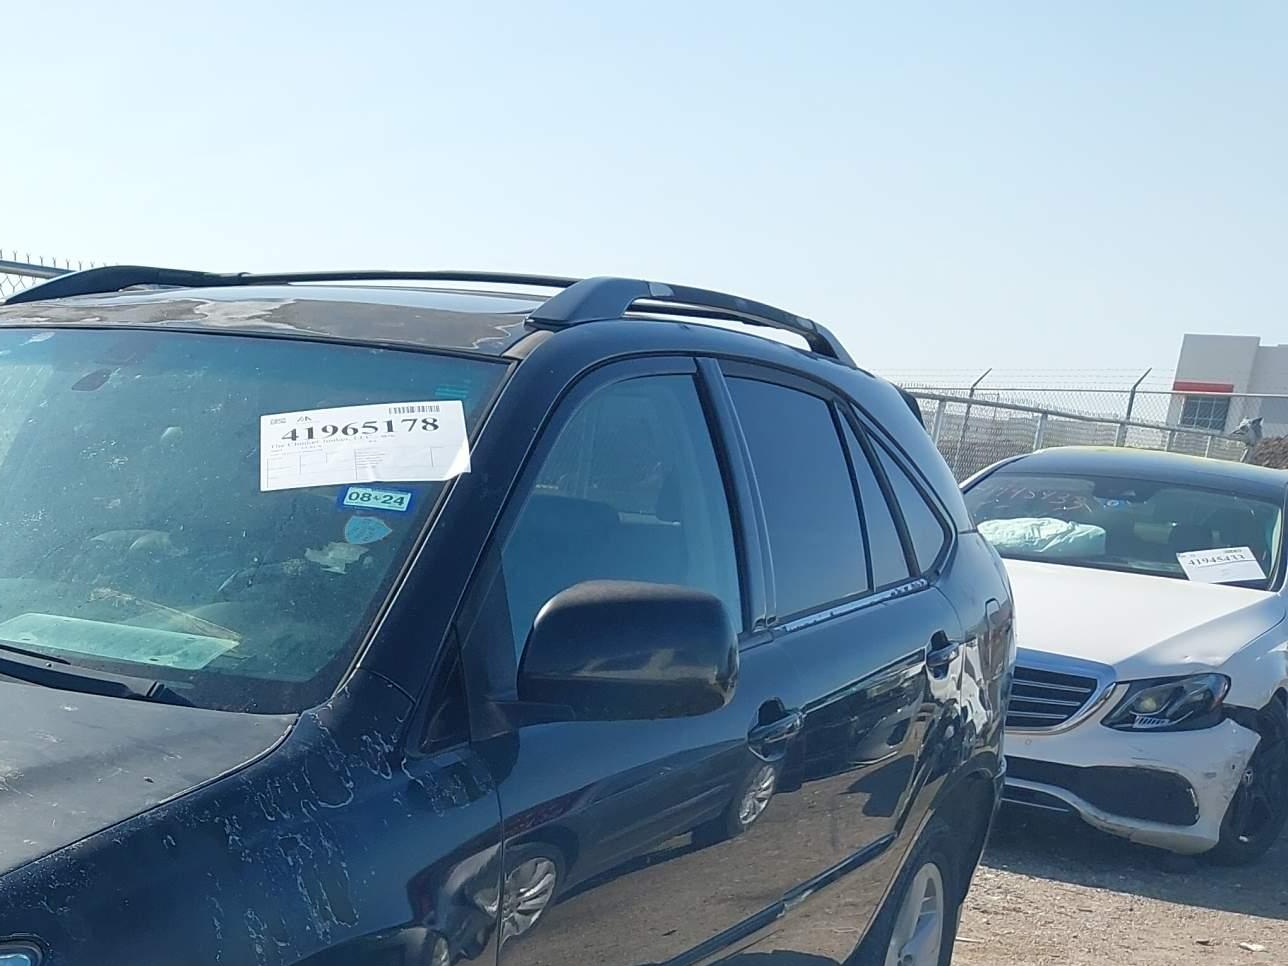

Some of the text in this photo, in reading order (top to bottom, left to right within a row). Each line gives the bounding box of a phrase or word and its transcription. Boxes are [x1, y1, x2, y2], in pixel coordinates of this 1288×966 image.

[281, 416, 440, 442] 41965178
[348, 491, 405, 507] 08 24
